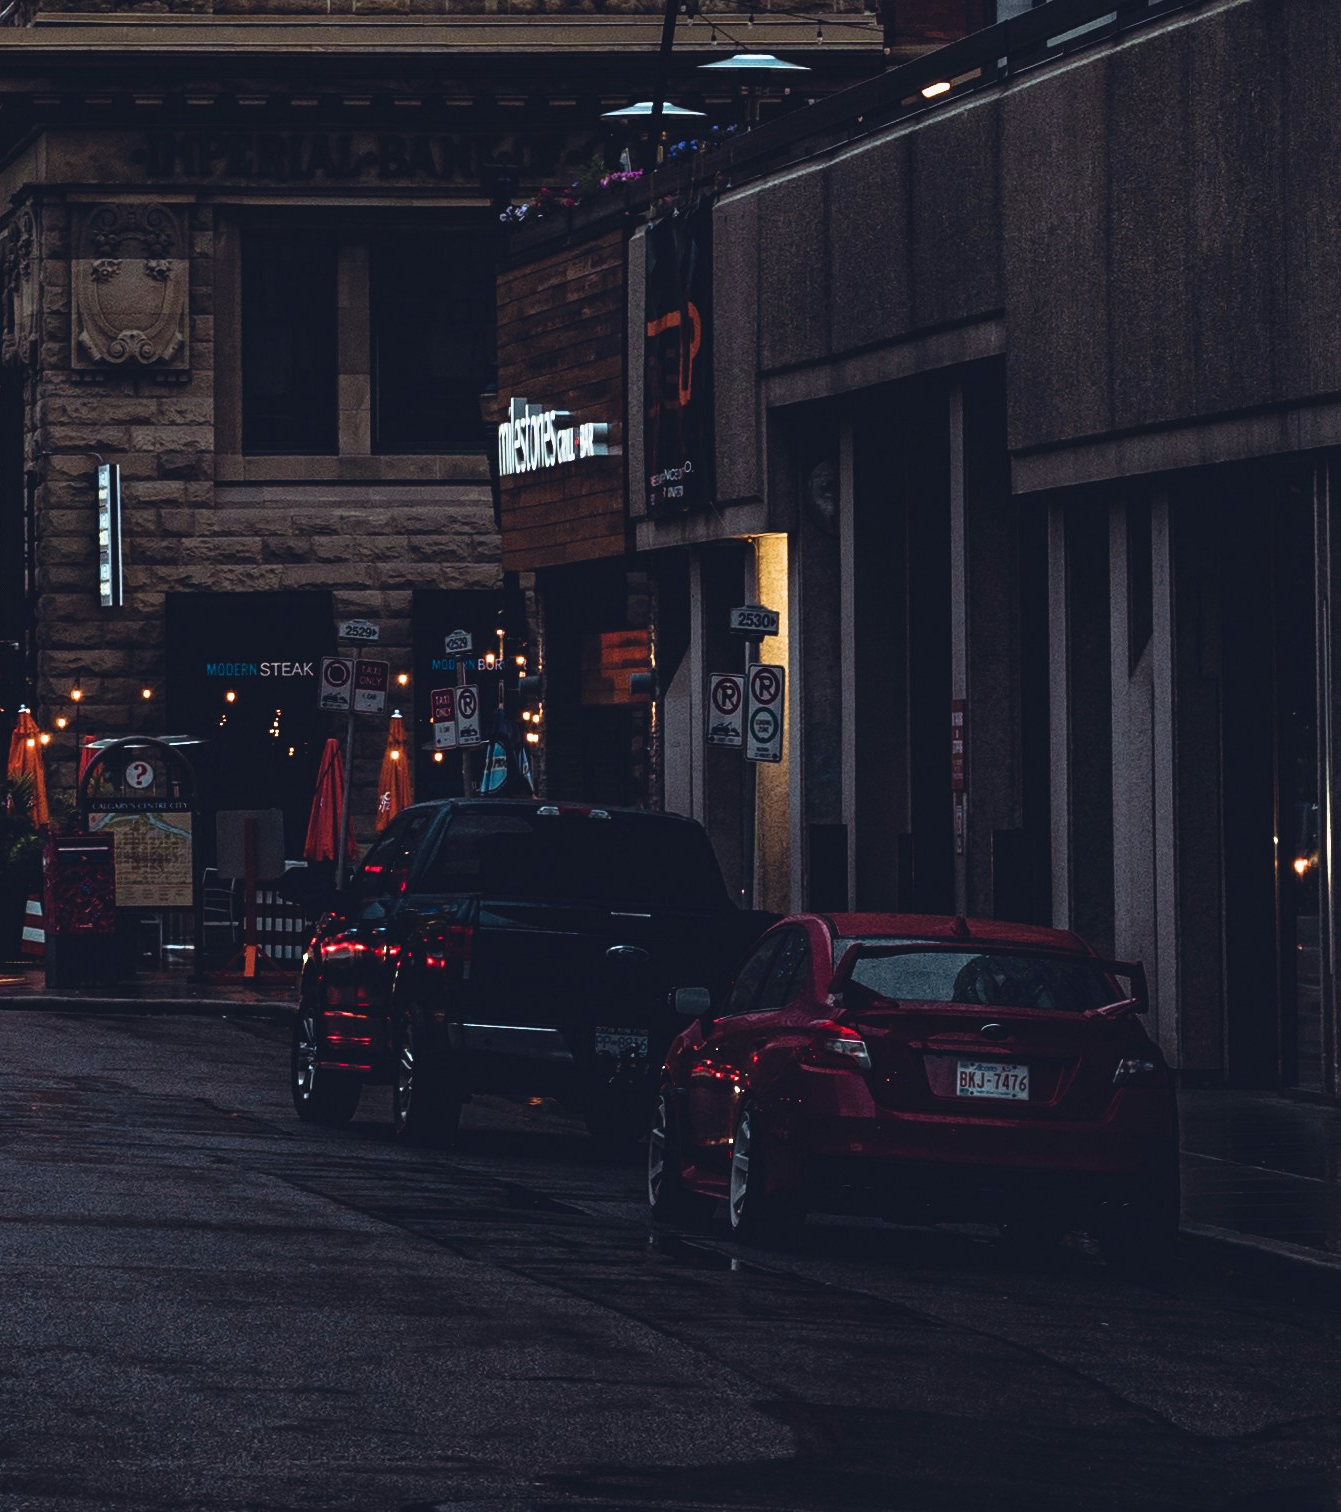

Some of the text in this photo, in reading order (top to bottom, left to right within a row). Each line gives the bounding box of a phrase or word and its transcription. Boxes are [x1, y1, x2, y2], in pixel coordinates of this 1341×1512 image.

[148, 135, 357, 179] IMPERIAL
[498, 397, 556, 477] milestones
[738, 612, 770, 628] 2530
[345, 625, 373, 638] 2529
[206, 662, 314, 677] MODERN STEAK
[361, 665, 382, 675] TAXI
[432, 659, 475, 671] MODN
[359, 676, 382, 686] ONLY
[169, 802, 188, 810] CITY
[960, 1071, 1027, 1092] BKJ-7476
